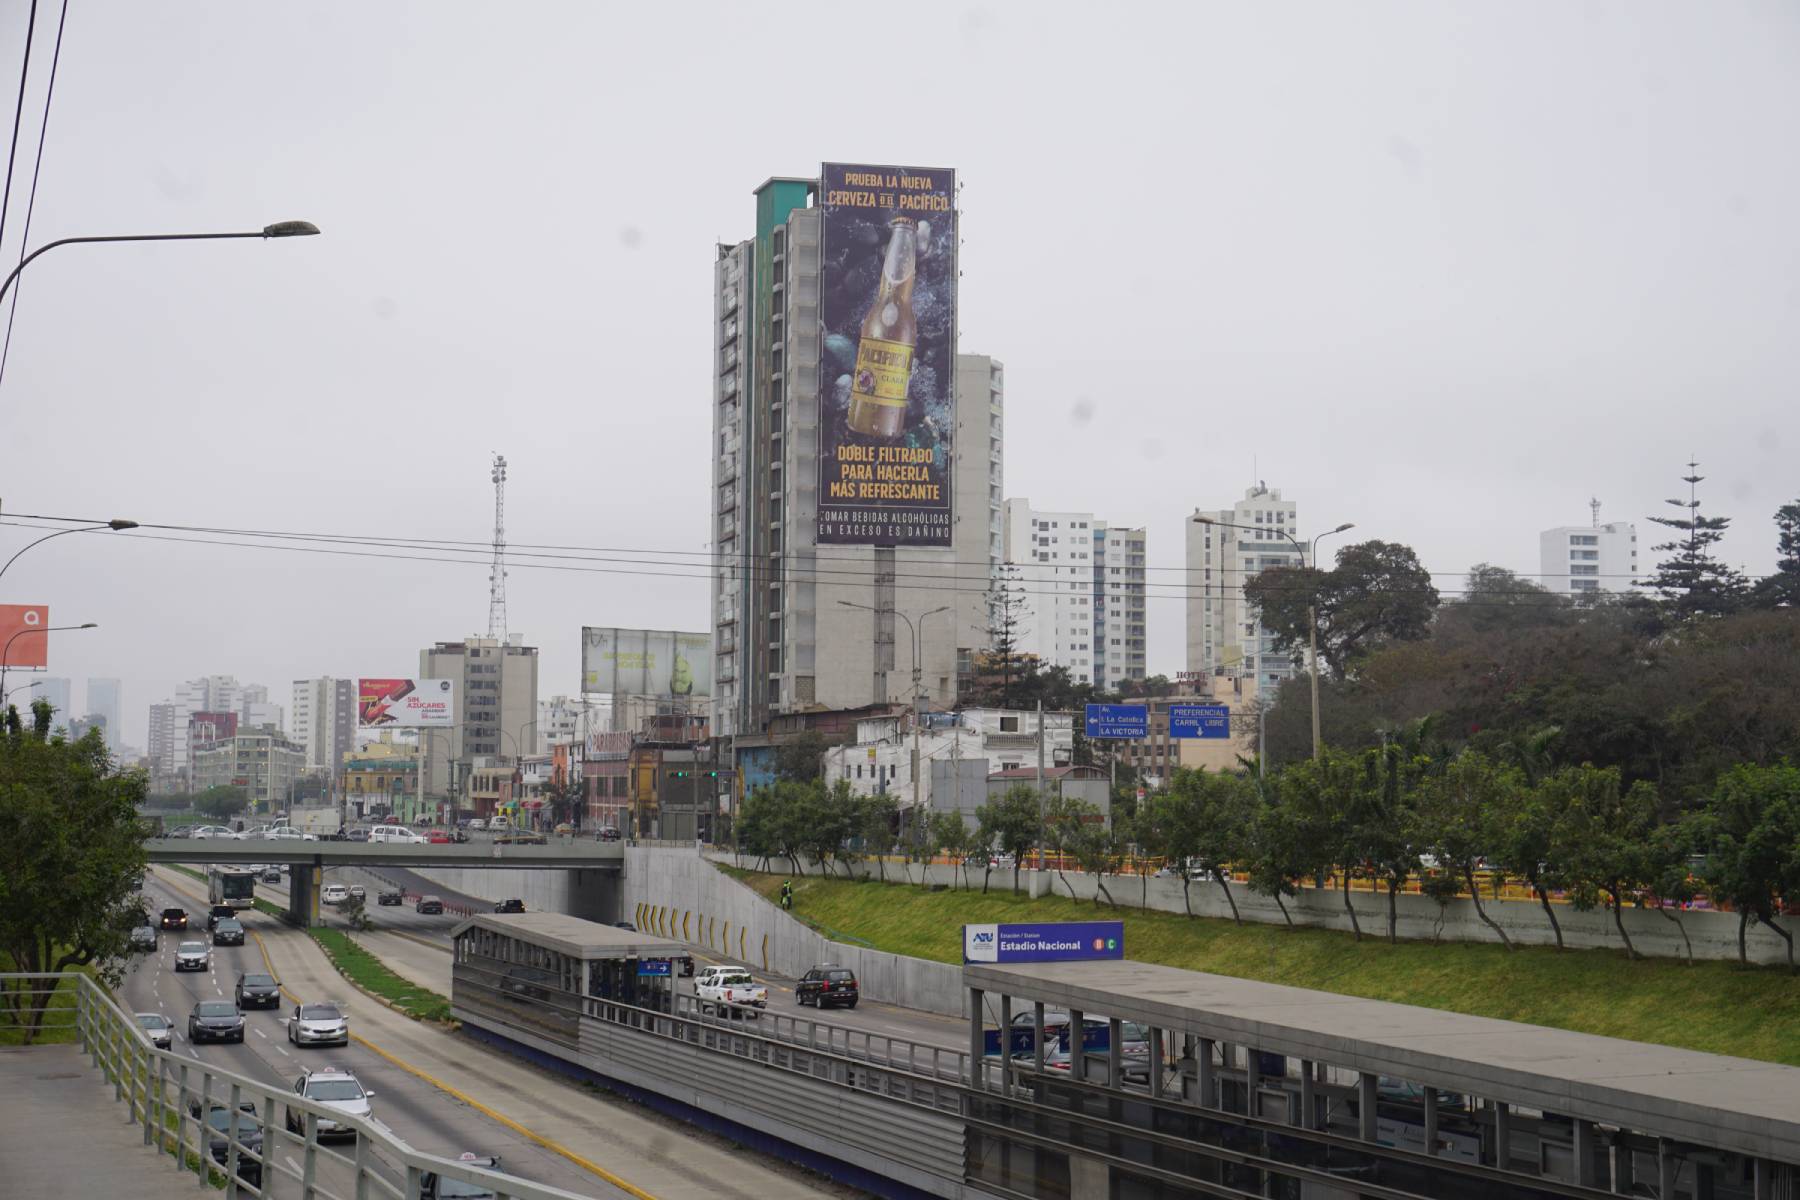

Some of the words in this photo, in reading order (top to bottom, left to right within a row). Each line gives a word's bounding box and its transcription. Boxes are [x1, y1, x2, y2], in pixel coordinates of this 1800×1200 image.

[845, 172, 883, 187] PRUEBA
[886, 175, 897, 188] LA
[901, 176, 932, 190] NUEVA
[829, 190, 876, 207] CERVEZA
[900, 193, 950, 211] PACÍFICO
[838, 446, 875, 461] DOBLE
[879, 446, 933, 463] FILTRADO
[841, 464, 873, 480] PARA
[877, 465, 929, 481] HACERLA
[830, 480, 855, 497] MÁS
[860, 482, 940, 500] REFRESCANTE
[852, 511, 888, 523] BEBIDAS
[892, 512, 949, 525] ALCOHÓLICAS
[820, 524, 832, 535] EN
[839, 524, 881, 536] EXCESO
[888, 525, 901, 537] ES
[908, 525, 949, 538] DAÑINO
[1174, 708, 1225, 717] PREFERENCIAL
[1174, 718, 1200, 727] CARRIL
[1204, 719, 1225, 727] LIBRE
[1100, 727, 1110, 735] LA
[1112, 727, 1144, 736] VICTORIA
[973, 932, 993, 942] ATU
[1000, 941, 1036, 951] Estadio
[1038, 940, 1080, 951] Nacional
